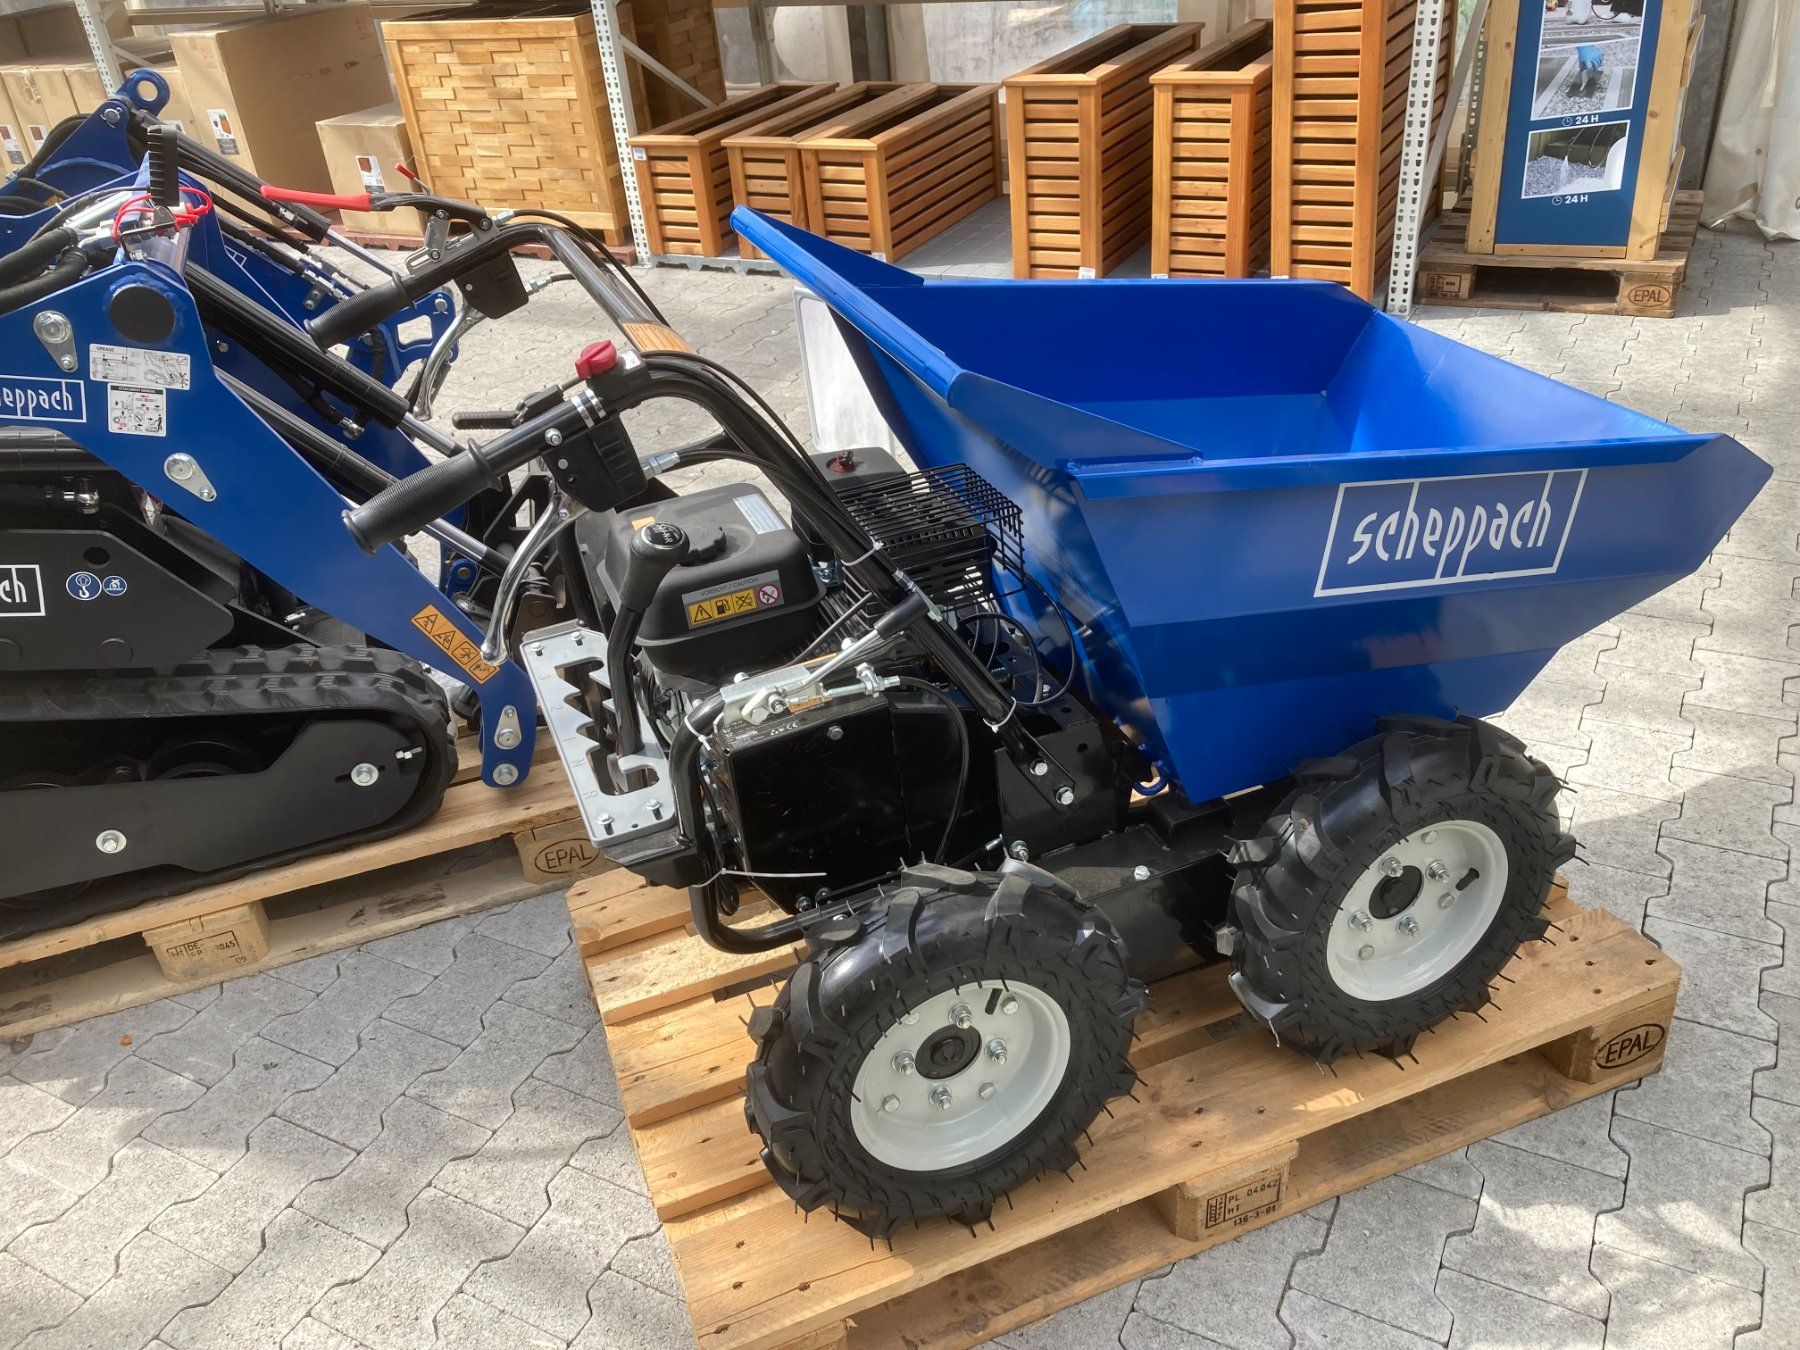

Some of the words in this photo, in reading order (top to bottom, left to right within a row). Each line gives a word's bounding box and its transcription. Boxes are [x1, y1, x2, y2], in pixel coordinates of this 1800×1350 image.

[1575, 116, 1589, 125] 24
[1590, 114, 1600, 123] H
[1564, 195, 1579, 204] 24
[1580, 194, 1588, 203] H
[1633, 289, 1664, 303] EPAL
[1347, 472, 1555, 580] scheppach
[544, 844, 593, 869] EPAL
[1605, 1030, 1655, 1064] EPAL
